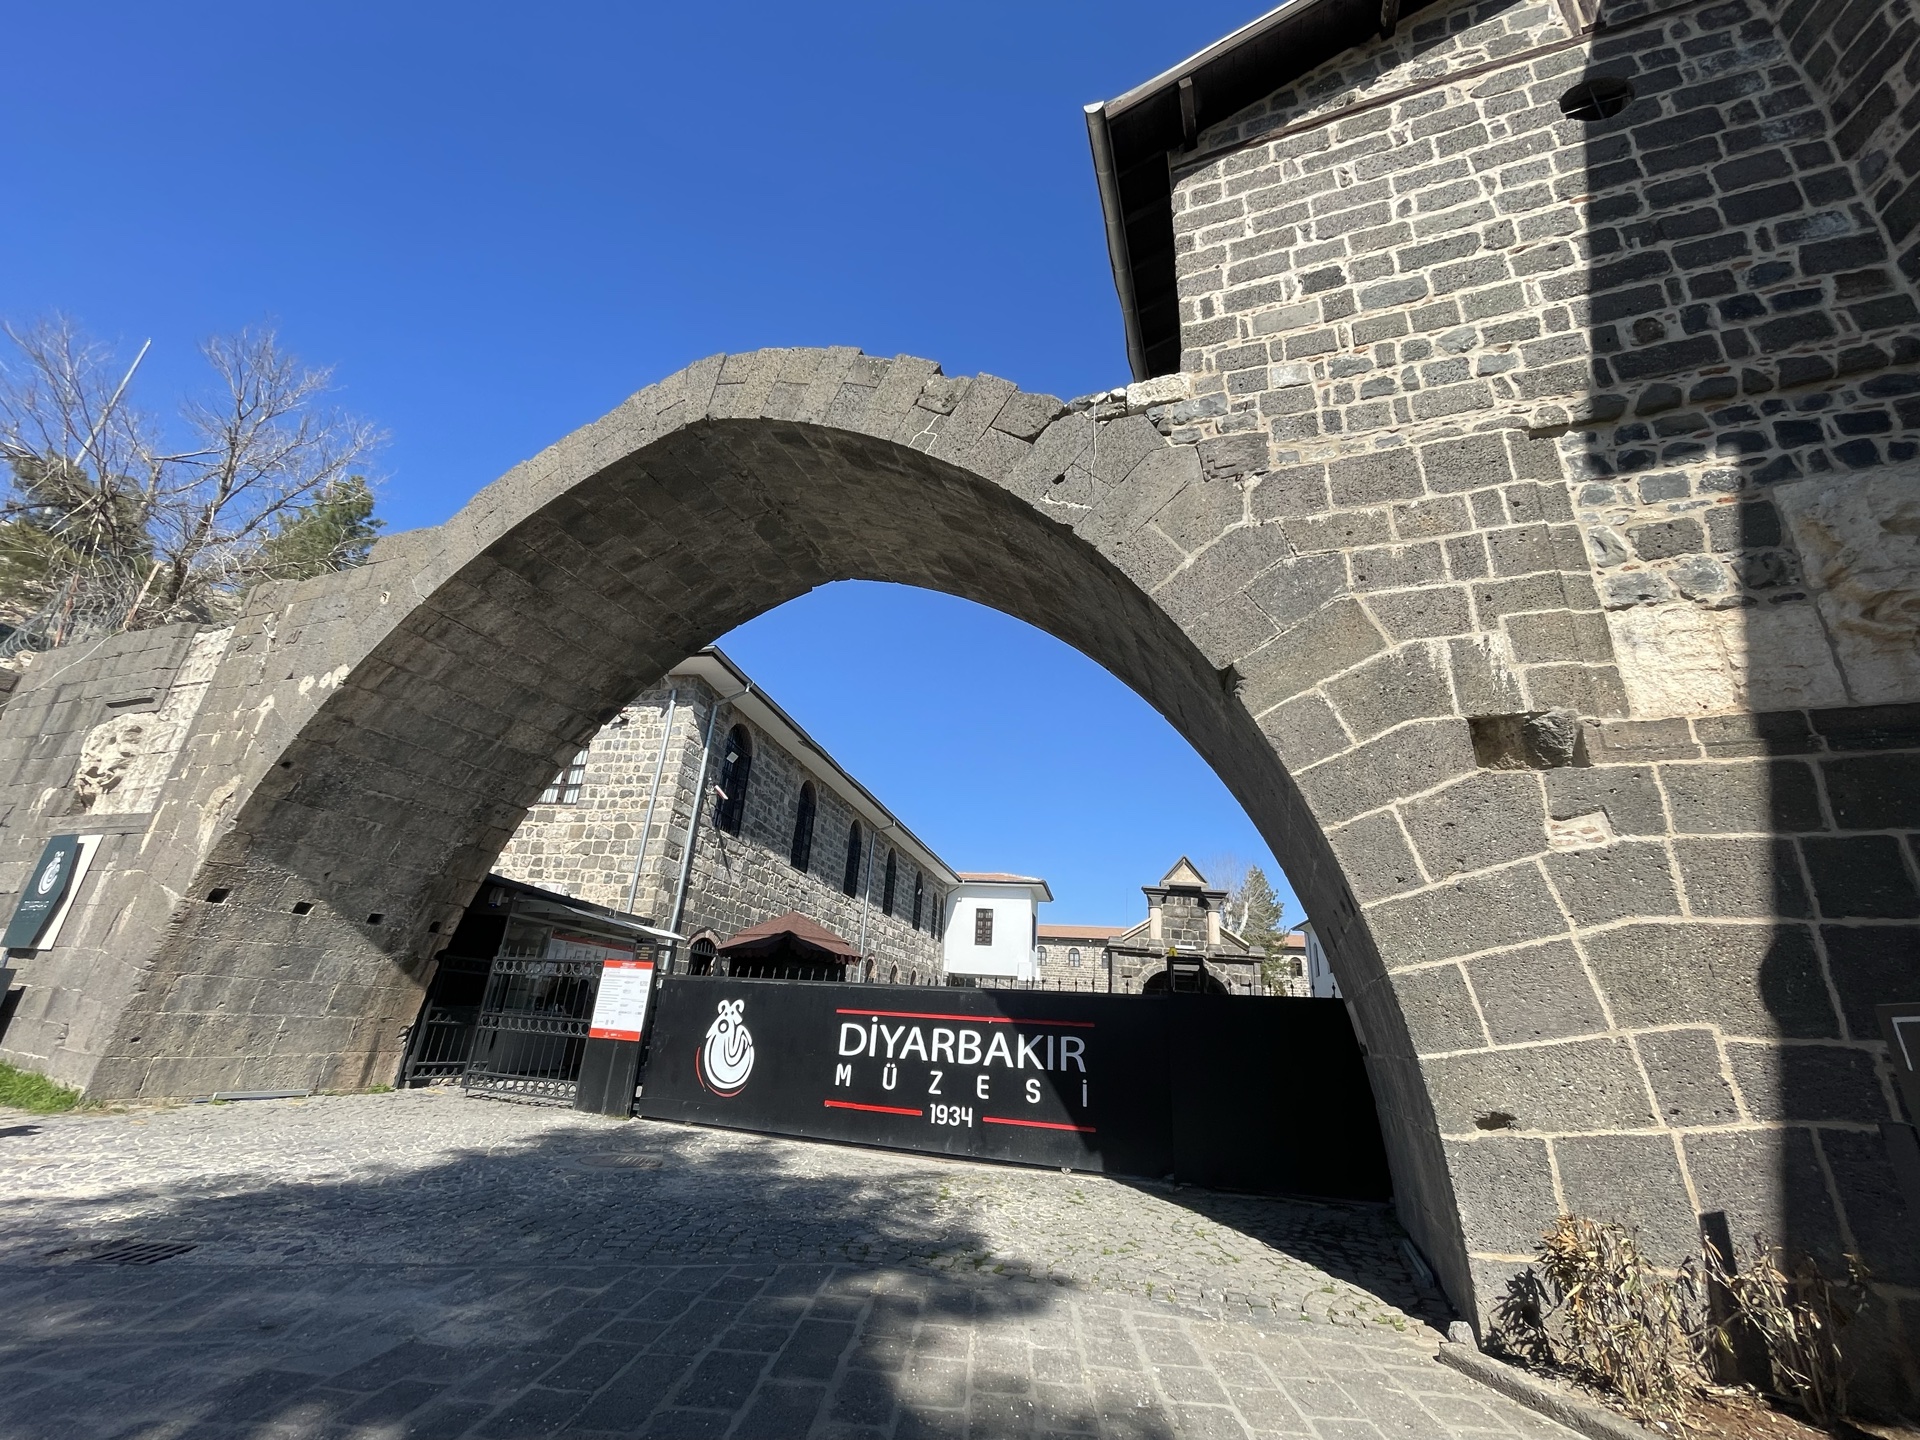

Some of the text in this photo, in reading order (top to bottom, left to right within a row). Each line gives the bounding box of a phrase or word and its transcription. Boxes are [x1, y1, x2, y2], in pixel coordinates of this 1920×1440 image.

[838, 1015, 1088, 1073] DİYARBAKIR
[834, 1062, 1089, 1108] MÜZESİ
[929, 1102, 974, 1128] 1934
